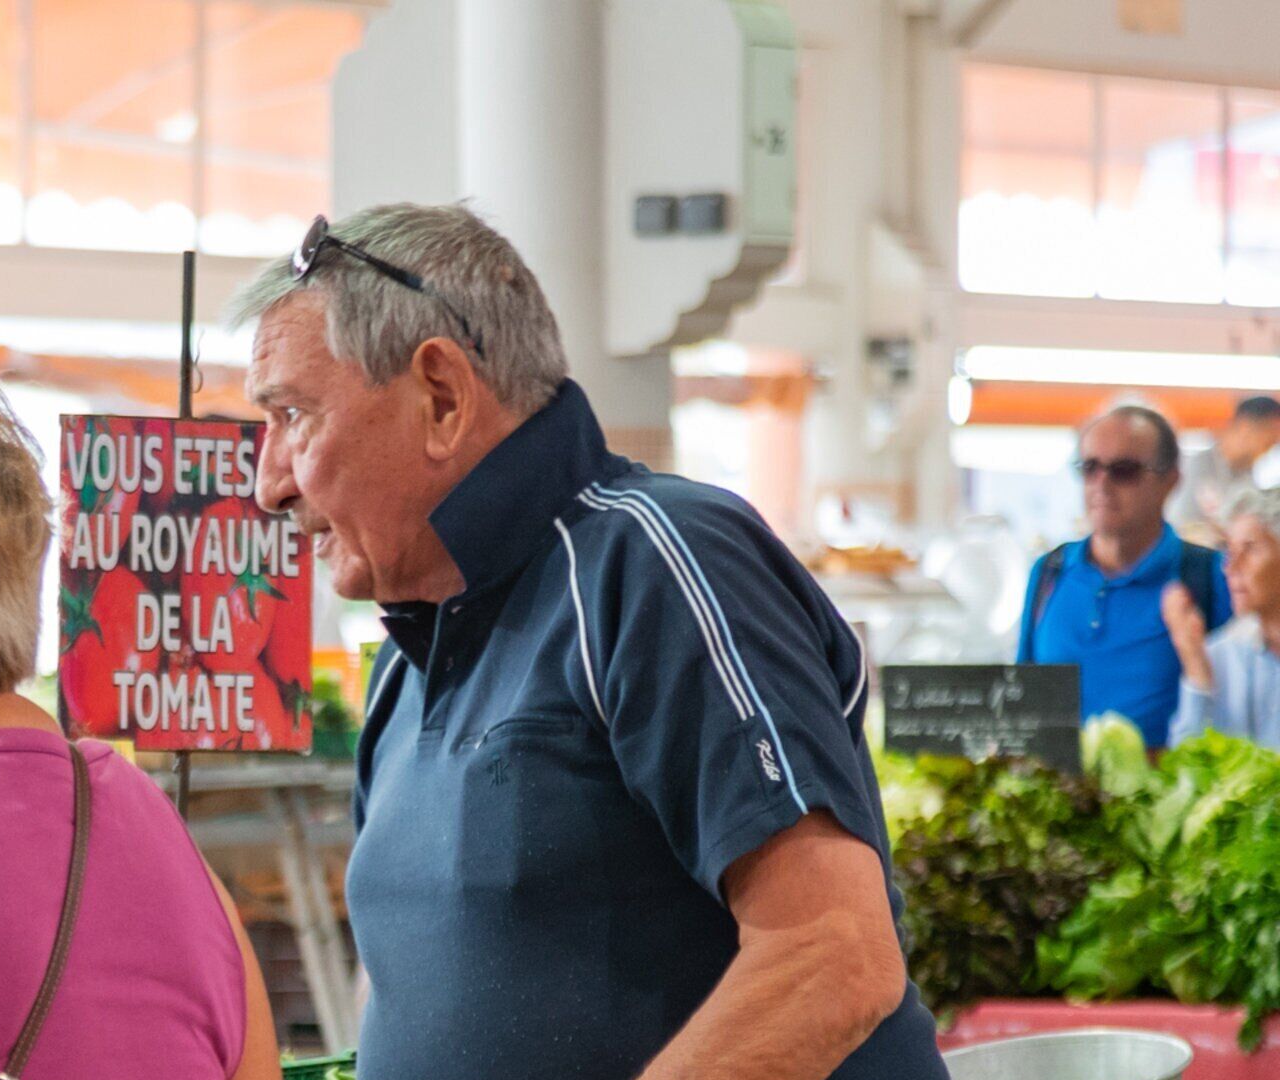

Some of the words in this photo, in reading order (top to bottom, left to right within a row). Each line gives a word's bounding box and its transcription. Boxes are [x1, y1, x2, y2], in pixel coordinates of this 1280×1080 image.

[65, 432, 163, 495] VOUS
[173, 436, 256, 498] ETES
[69, 511, 120, 571] AU
[129, 514, 300, 577] ROYAUME
[135, 593, 182, 652] DE
[192, 595, 234, 653] LA
[113, 671, 256, 732] TOMATE
